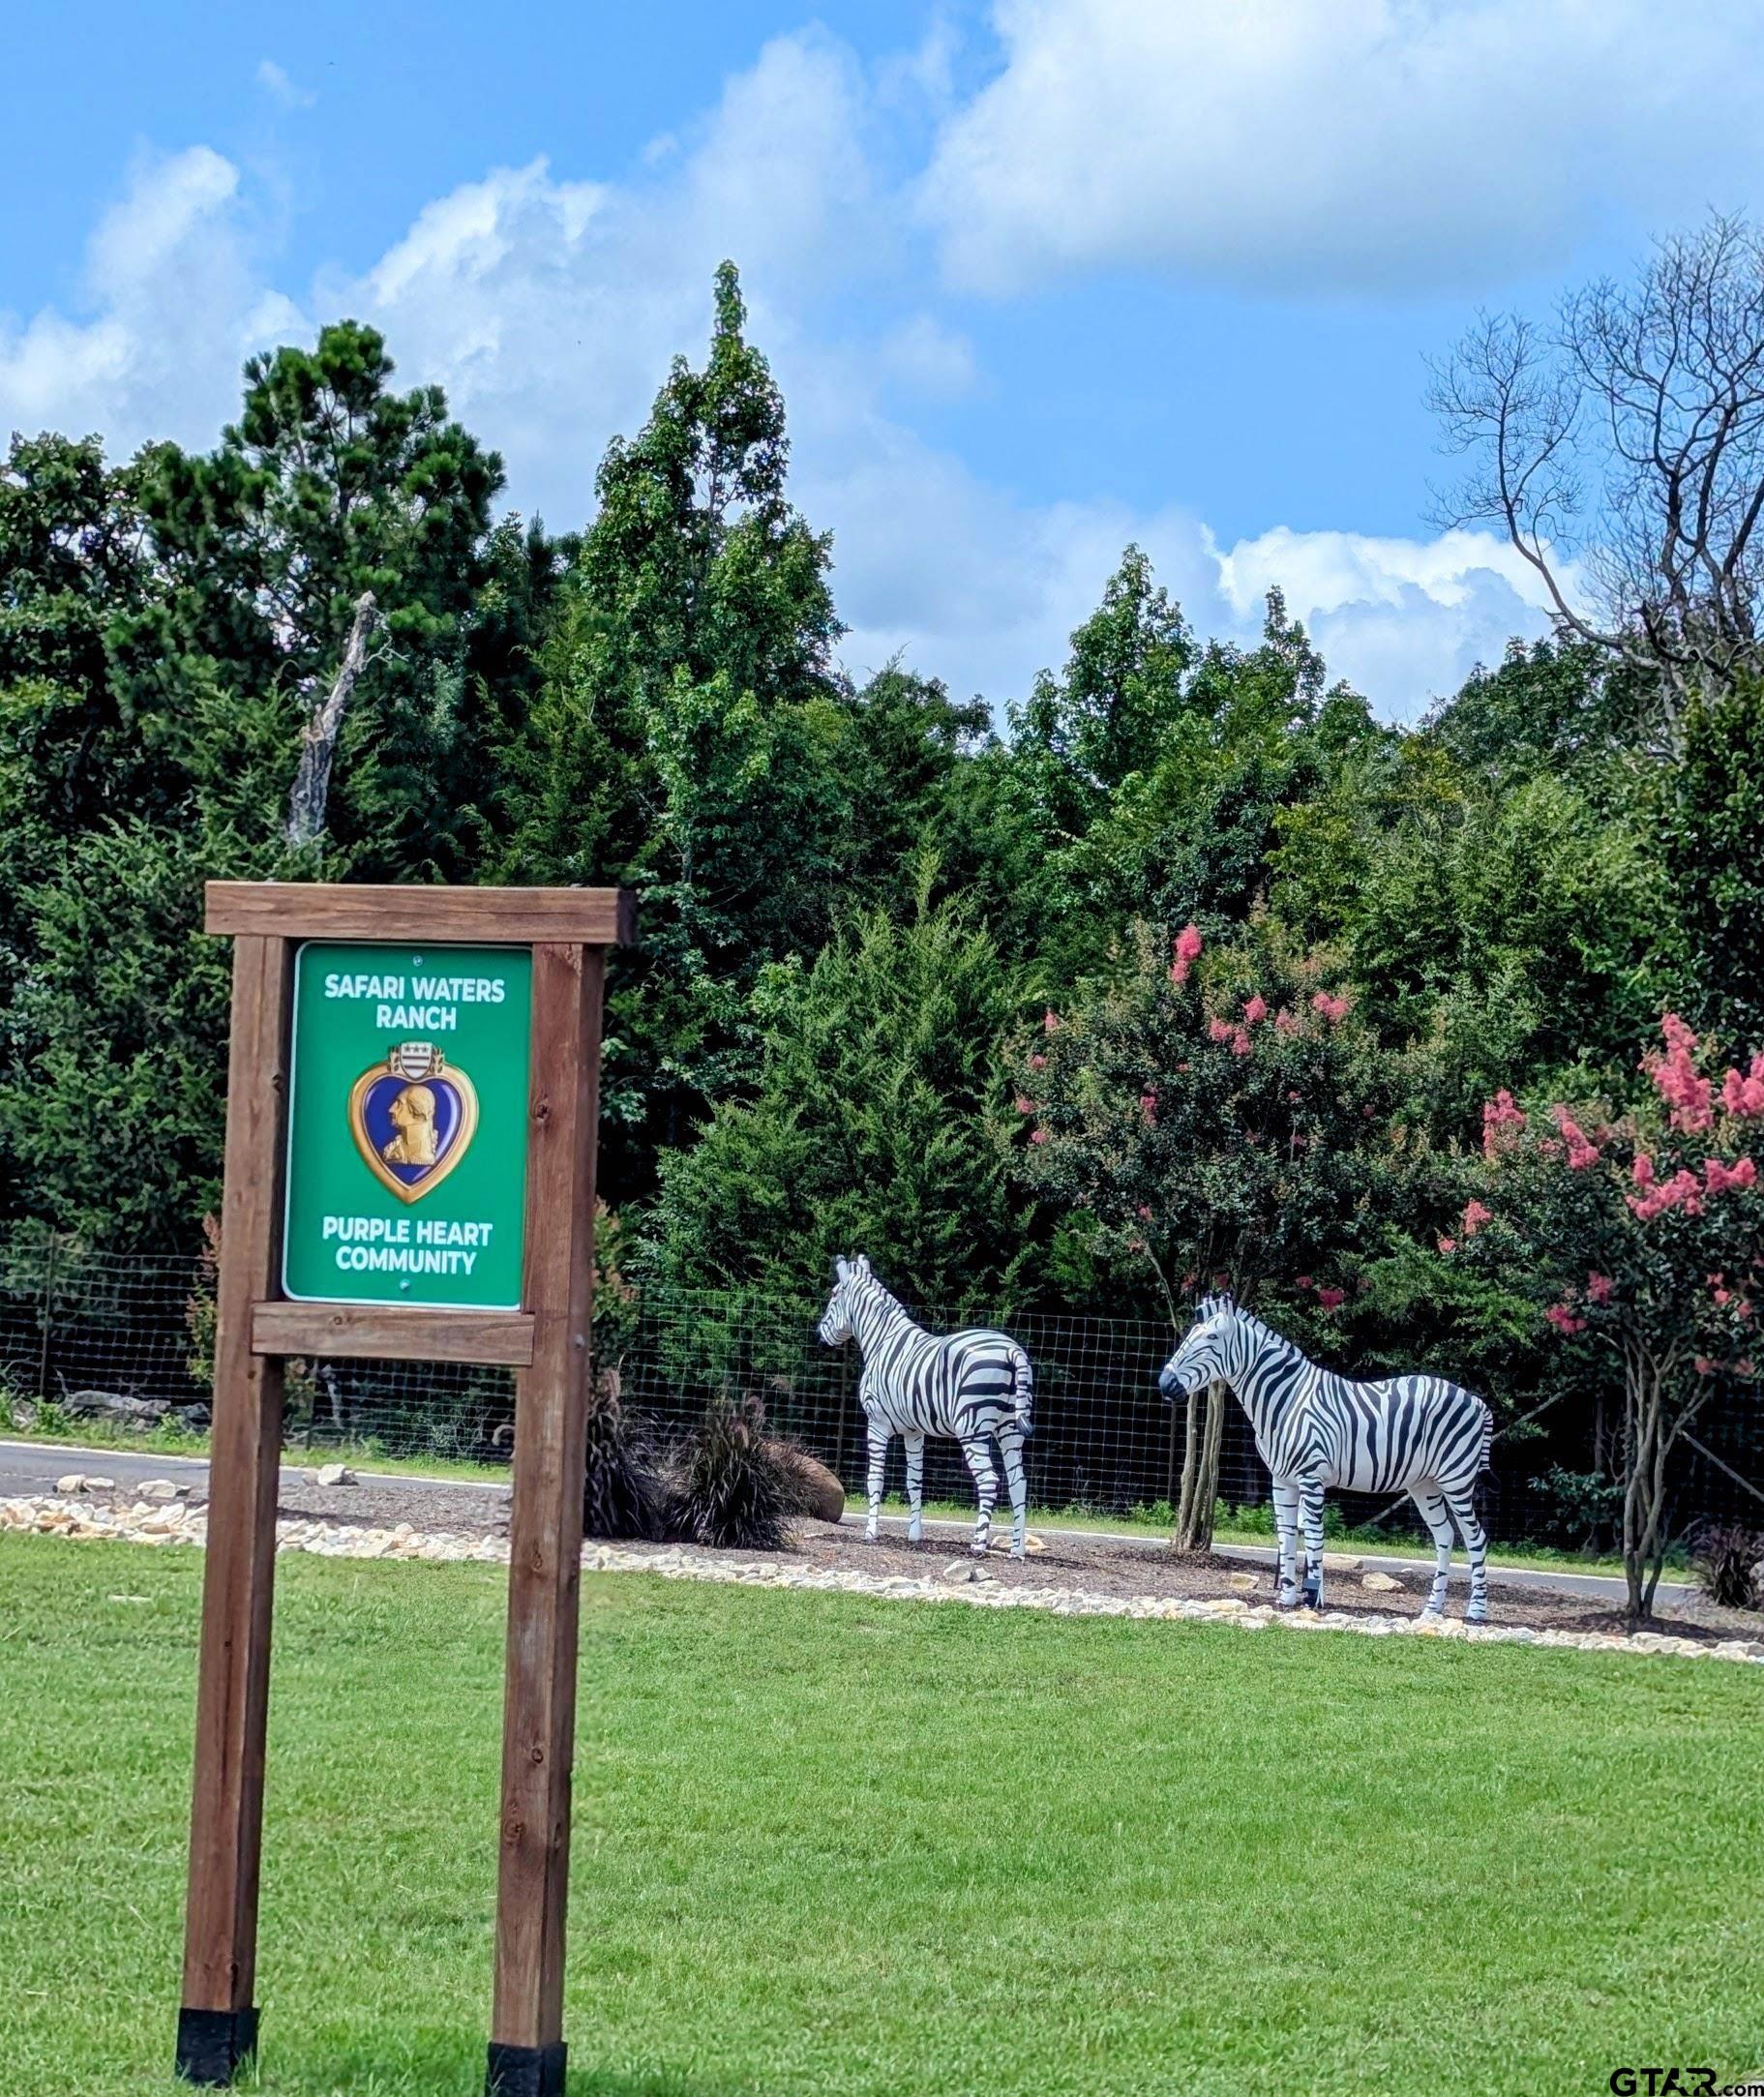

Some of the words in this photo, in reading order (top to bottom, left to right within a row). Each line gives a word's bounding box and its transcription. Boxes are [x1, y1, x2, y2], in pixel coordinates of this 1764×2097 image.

[324, 974, 404, 1000] SAFARI
[412, 977, 505, 1003] WATERS
[375, 1004, 457, 1031] RANCH
[322, 1216, 409, 1243] PURPLE
[416, 1219, 493, 1246] HEART
[335, 1245, 477, 1274] COMMUNITY
